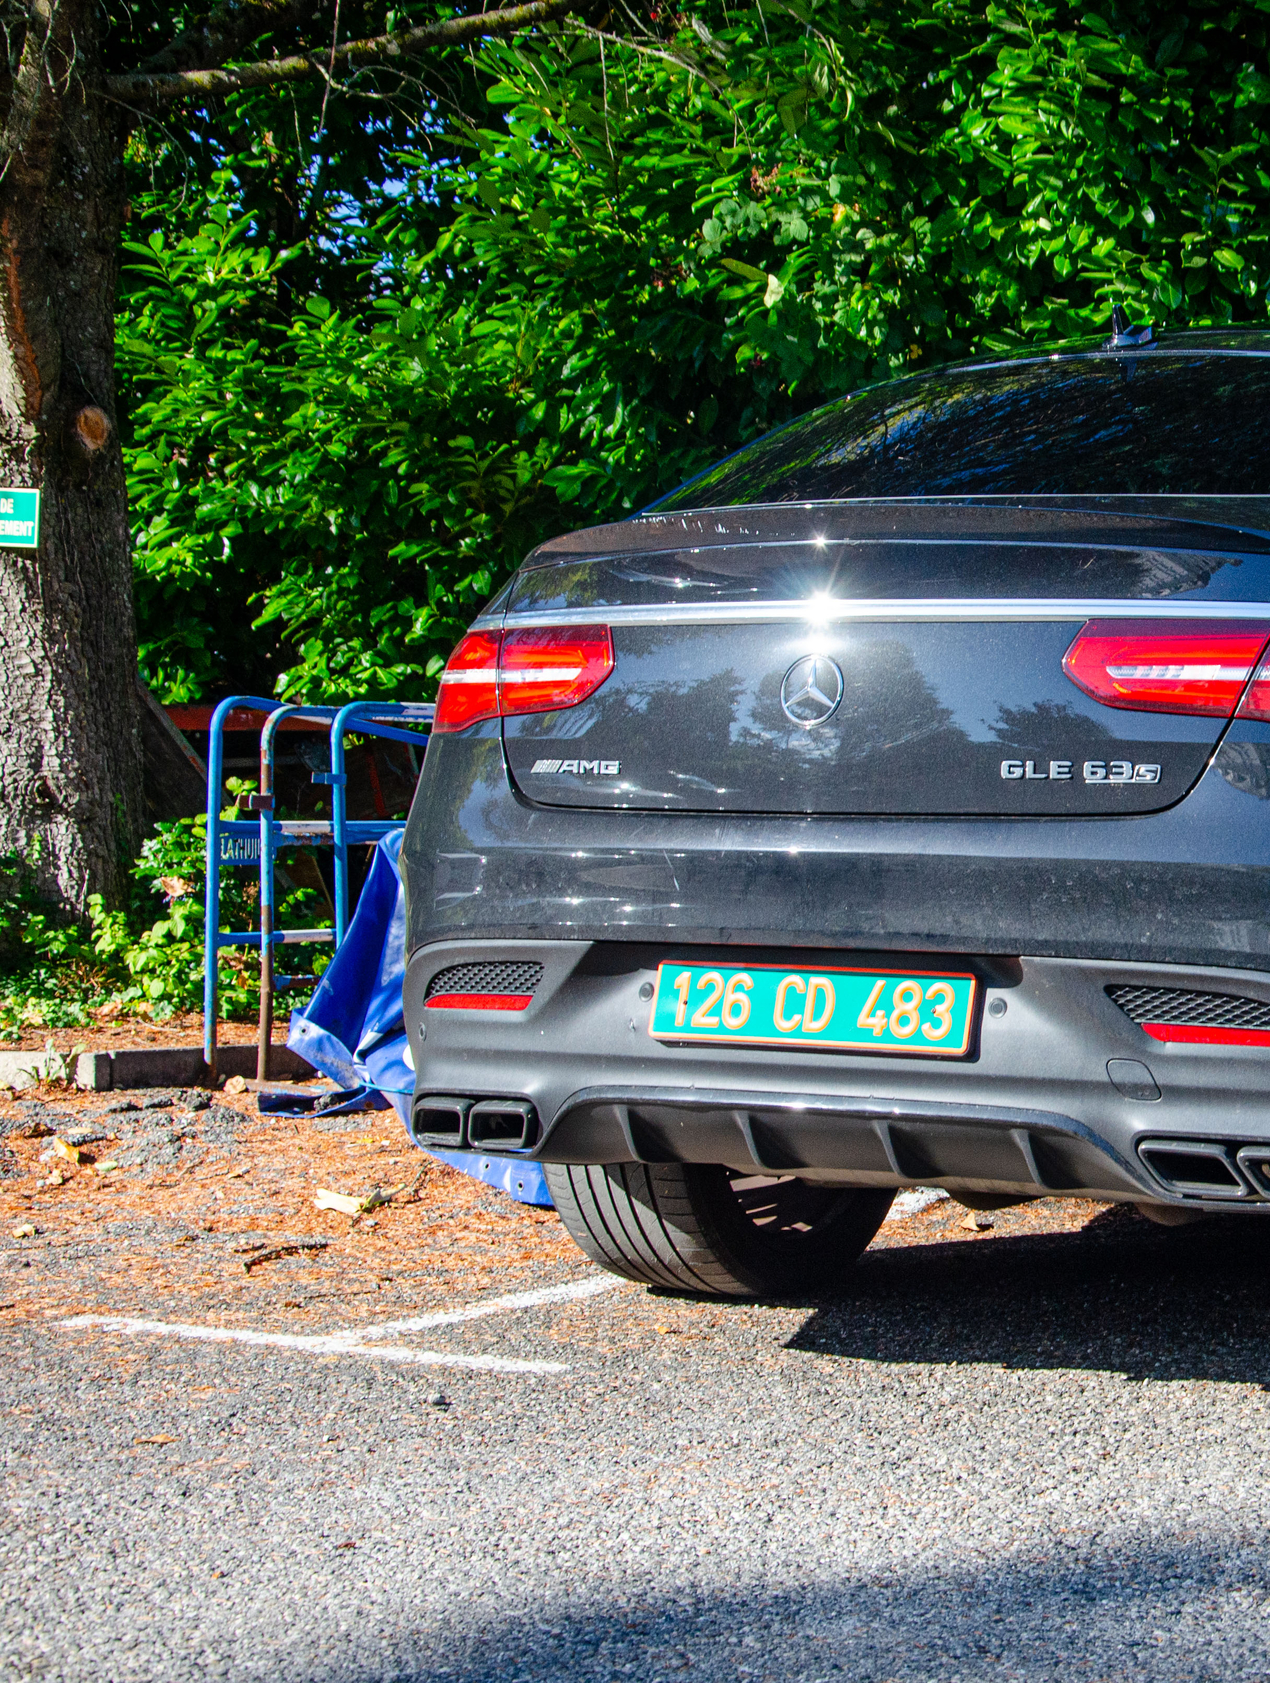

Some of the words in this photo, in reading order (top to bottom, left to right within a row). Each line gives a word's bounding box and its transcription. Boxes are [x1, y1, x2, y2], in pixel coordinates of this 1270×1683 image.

[557, 759, 620, 775] AMG
[1000, 759, 1073, 780] GLE
[674, 971, 754, 1030] 126
[773, 974, 836, 1033] CD
[857, 979, 956, 1041] 483
